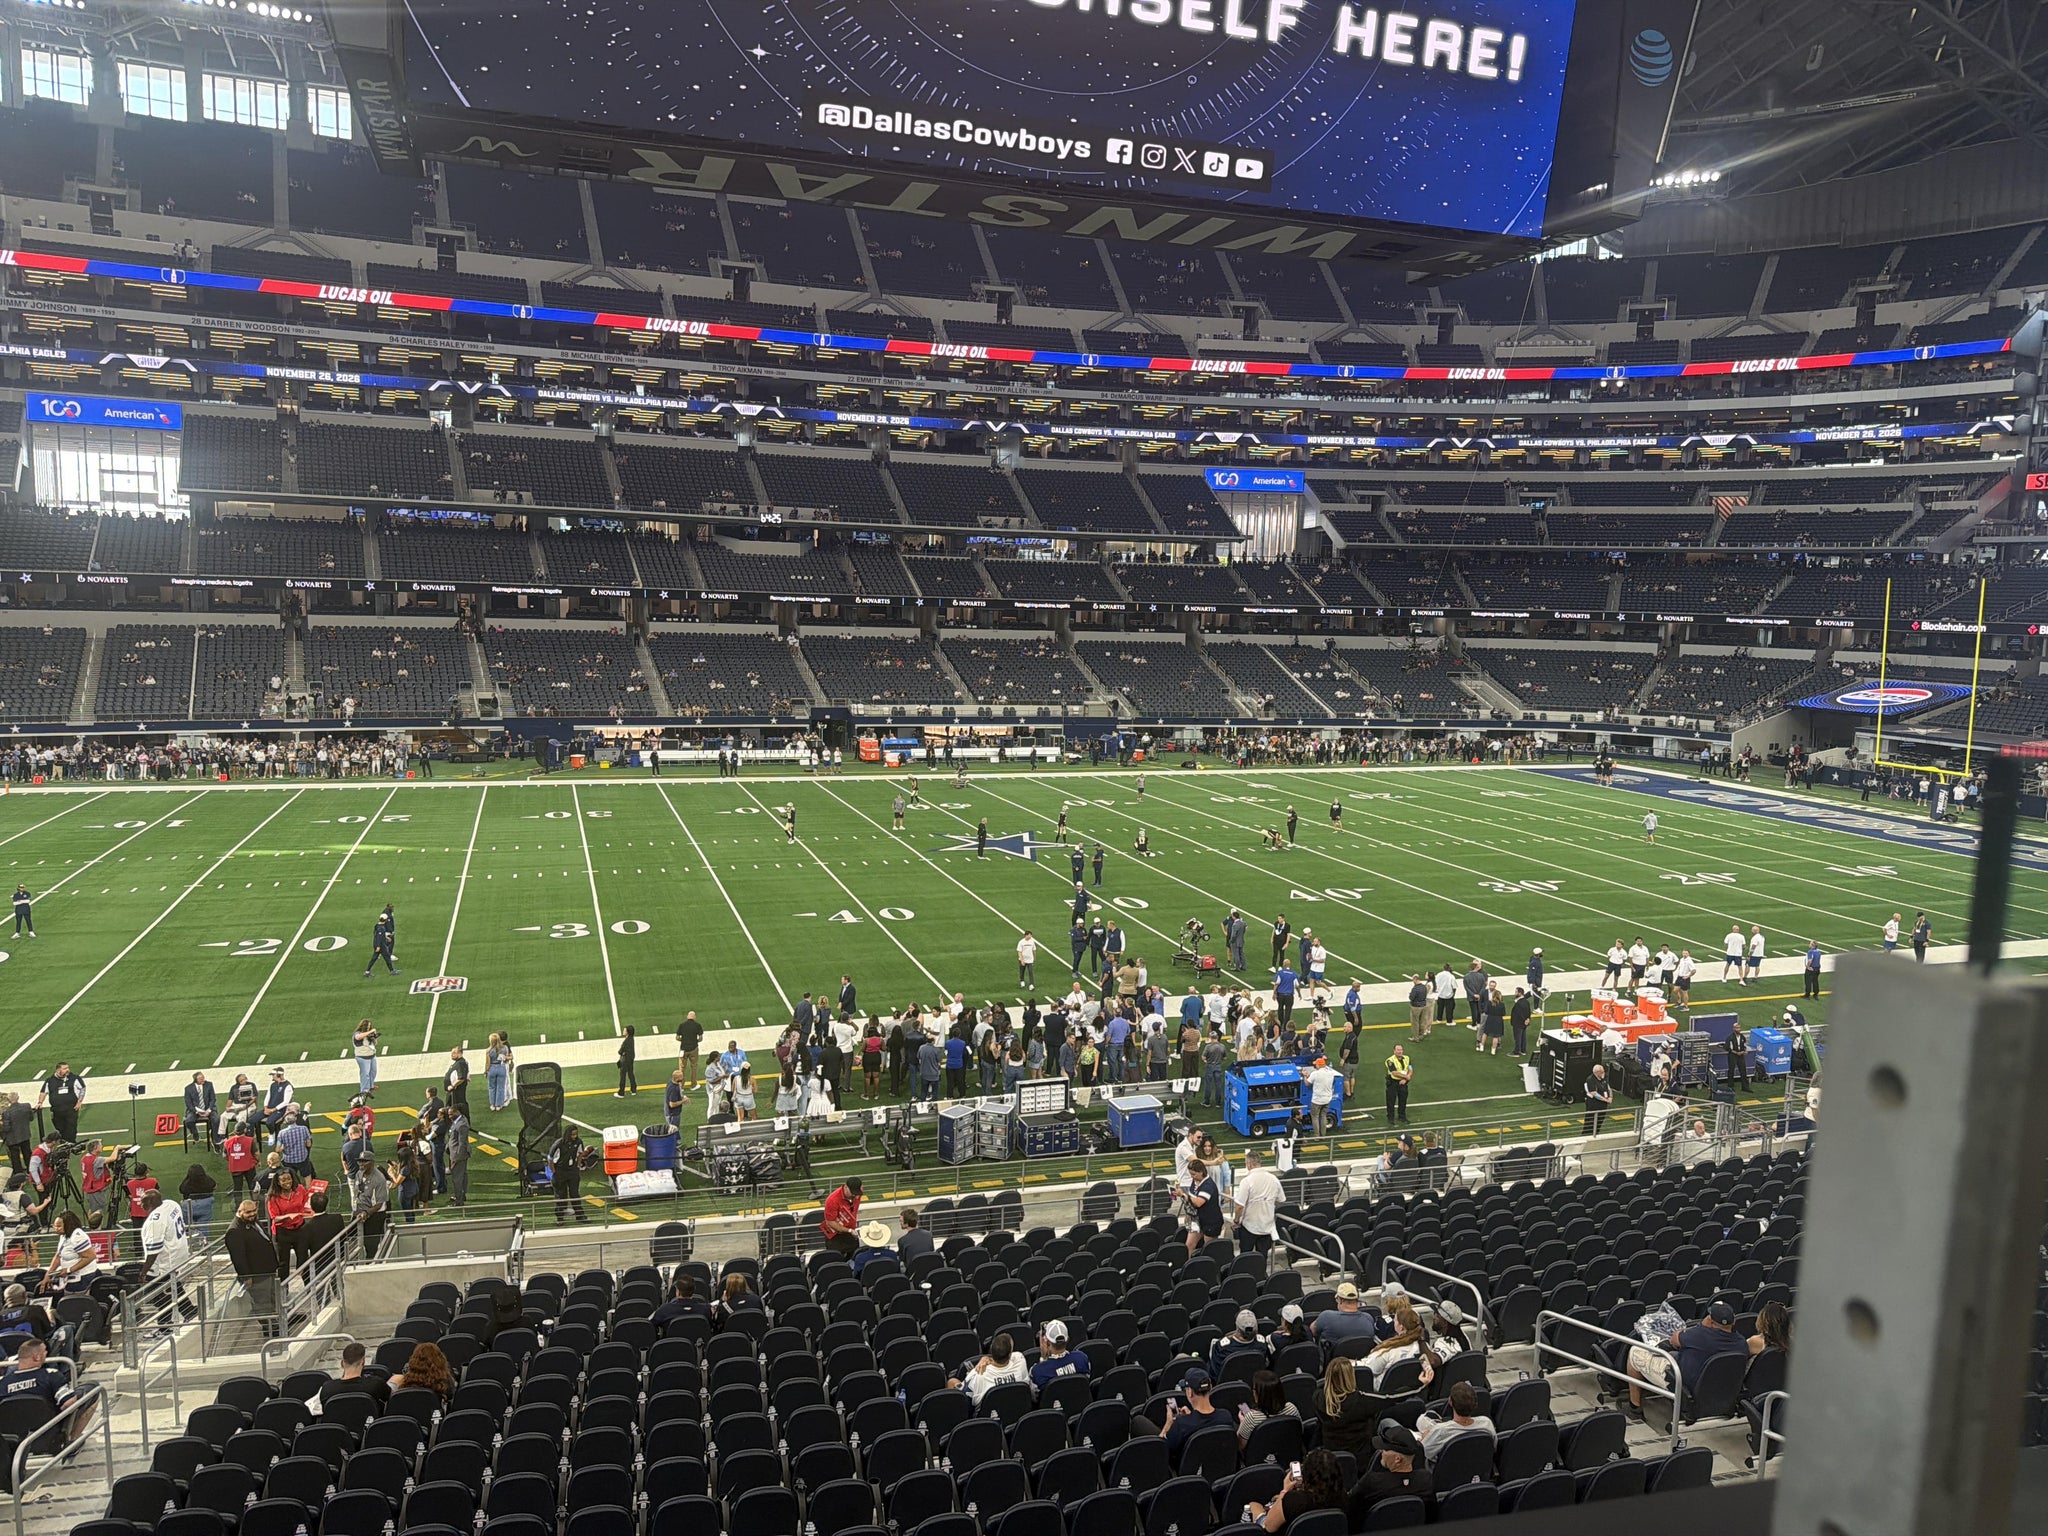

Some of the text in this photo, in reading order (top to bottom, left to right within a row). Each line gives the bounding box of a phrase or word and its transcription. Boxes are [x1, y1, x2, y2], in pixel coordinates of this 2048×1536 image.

[1335, 5, 1527, 82] HERE!
[356, 79, 409, 160] WINSTAR
[818, 103, 1091, 160] @DallasCowboys
[627, 148, 1357, 260] WINSTAR
[319, 285, 394, 305] LUCAS OIL
[31, 302, 77, 313] JOHNSON
[191, 317, 202, 325] 28
[204, 319, 242, 329] DARREN
[245, 323, 290, 333] WOODSON
[645, 318, 709, 335] LUCAS OIL
[401, 337, 438, 347] CHARLES
[440, 340, 466, 348] HALEY
[33, 348, 67, 359] EAGLES
[571, 352, 603, 360] MICHAEL
[930, 343, 988, 359] LUCAS OIL
[718, 365, 736, 373] TROY
[737, 367, 763, 375] AIKMAN
[1191, 359, 1246, 373] LUCAS OIL
[1732, 358, 1798, 373] LUCAS OIL
[267, 368, 316, 380] NOVEMBER
[1448, 368, 1505, 379] LUCAS OIL
[538, 390, 565, 399] DALLAS
[566, 391, 600, 402] COWBOYS
[614, 395, 662, 407] PHILADELPHIA
[662, 400, 688, 409] EAGLES
[41, 398, 154, 421] 100 American
[1051, 426, 1073, 435] DALLAS
[1074, 427, 1102, 436] COWBOYS
[1114, 430, 1153, 439] PHILADELPHIA
[1816, 431, 1859, 440] NOVEMBER
[1518, 439, 1542, 447] DALLAS
[1543, 439, 1574, 447] COWBOYS
[1587, 439, 1631, 447] PHILADELPHIA
[1213, 472, 1286, 486] 100 American
[87, 576, 128, 584] NOVARTIS
[172, 577, 206, 586] Reimagining
[295, 580, 332, 589] NOVARTIS
[421, 584, 456, 592] NOVARTIS
[598, 589, 630, 597] NOVARTIS
[708, 592, 738, 600] NOVARTIS
[1921, 621, 1986, 632] Blockchain.com
[1478, 879, 1558, 893] 30
[1290, 887, 1362, 902] 40
[827, 907, 915, 923] 40
[549, 919, 651, 939] 30
[229, 935, 349, 956] 20
[158, 1117, 176, 1132] 20
[1055, 1363, 1077, 1376] IRVIN
[7, 1378, 37, 1393] PRESCOTT
[994, 1373, 1016, 1386] IRVIN
